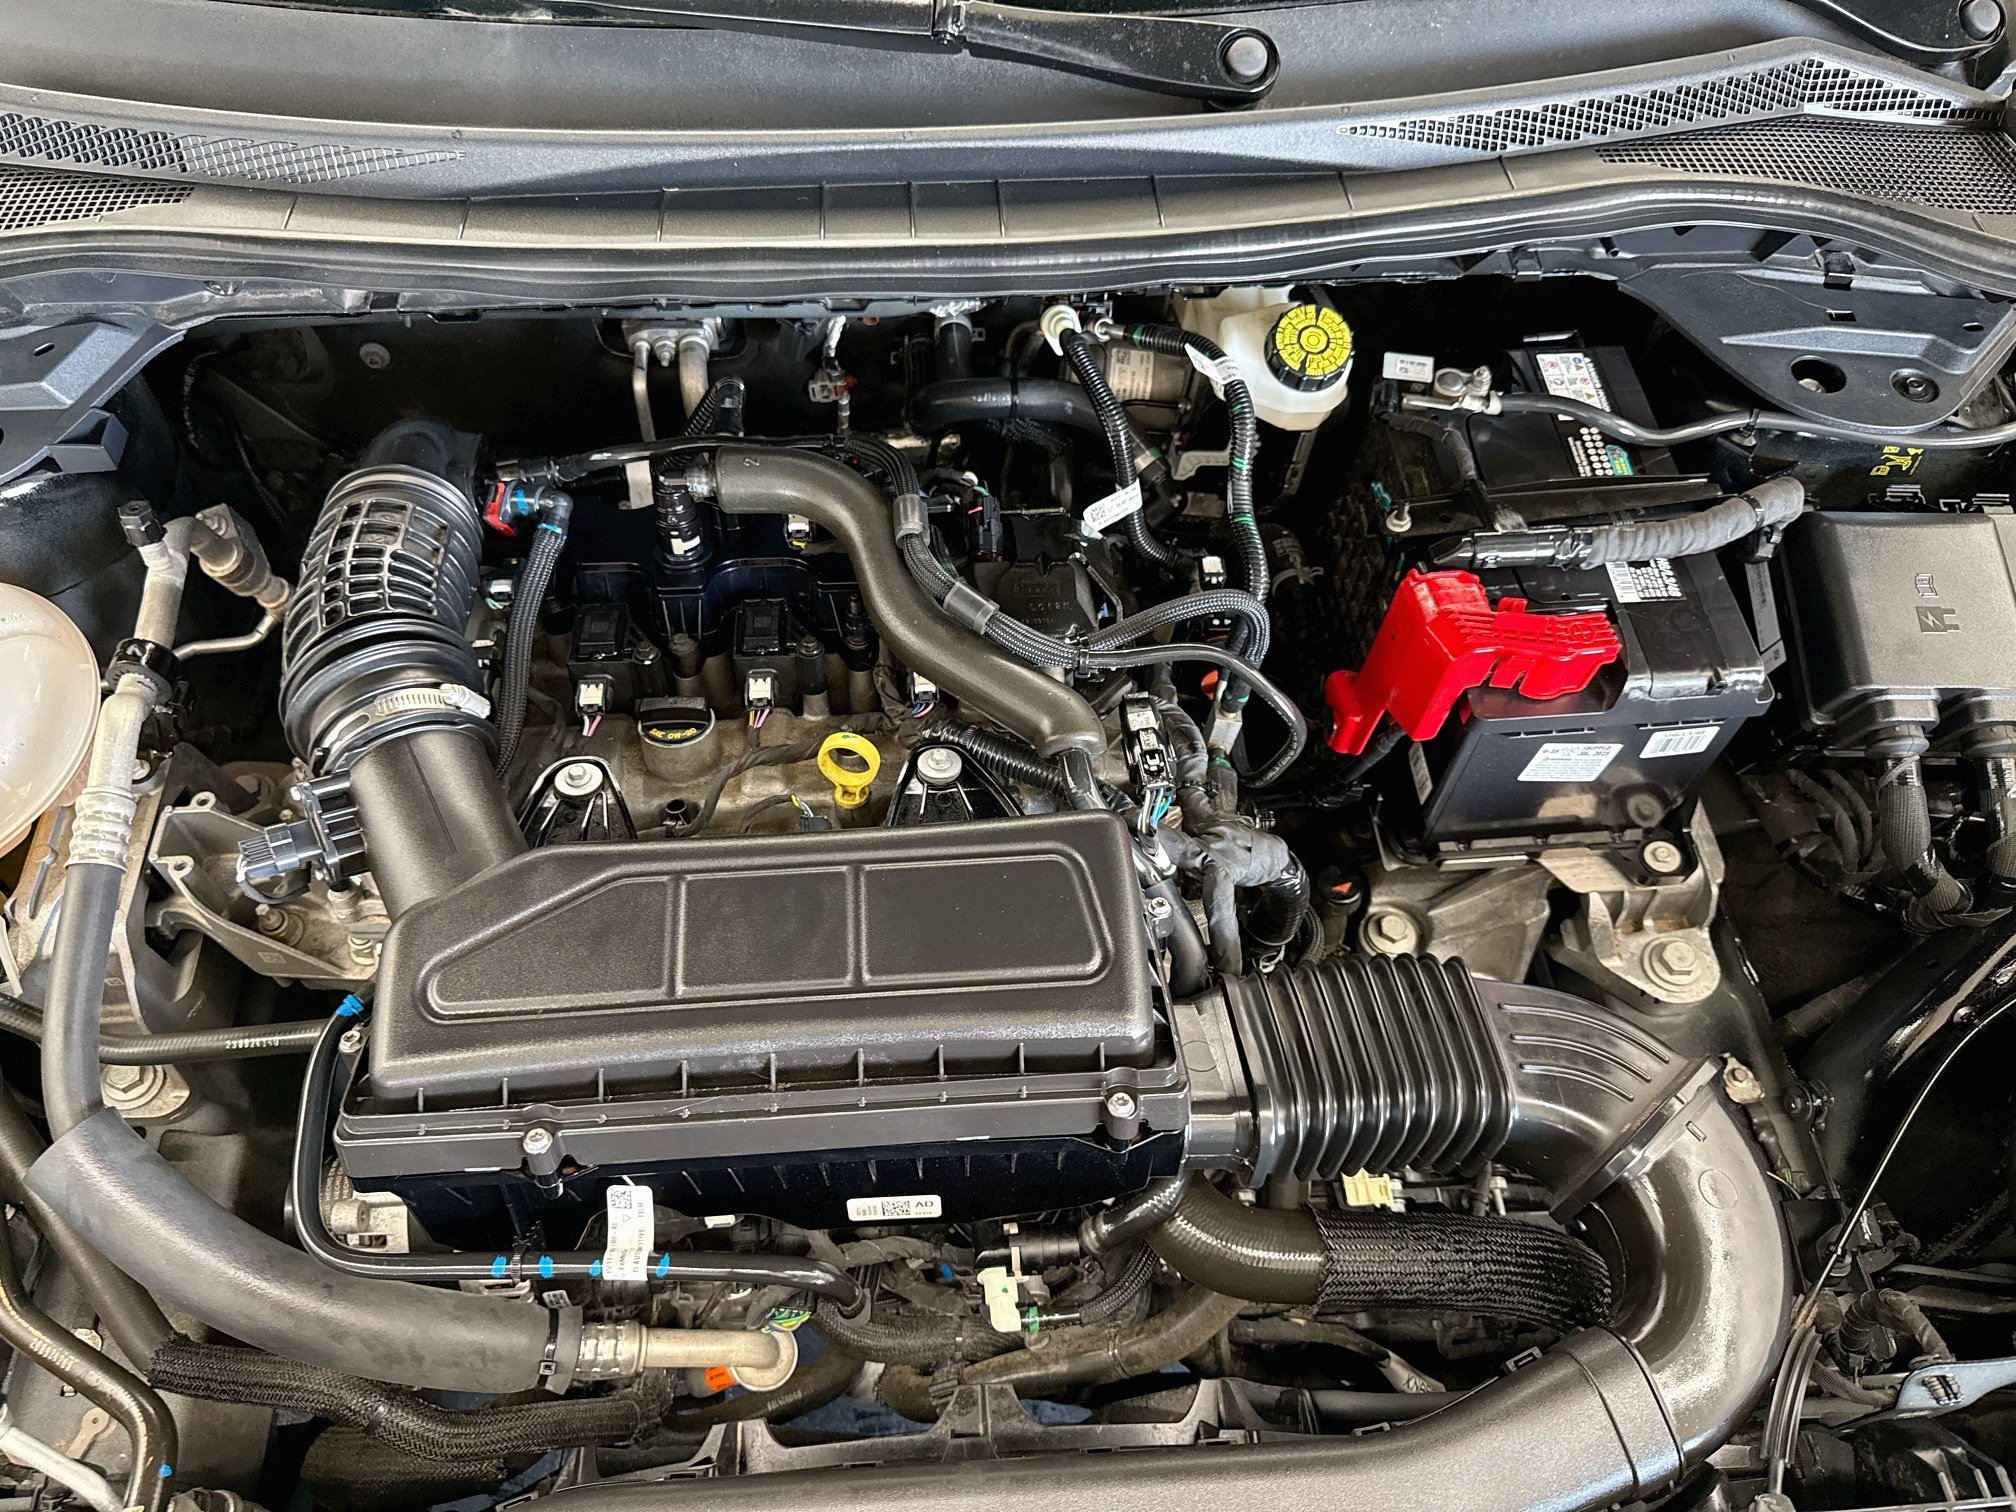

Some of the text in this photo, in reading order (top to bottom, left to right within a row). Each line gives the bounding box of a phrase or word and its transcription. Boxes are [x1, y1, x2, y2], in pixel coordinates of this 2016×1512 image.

[649, 728, 666, 738] SAE
[342, 1176, 350, 1199] HECH
[914, 1200, 934, 1208] AD
